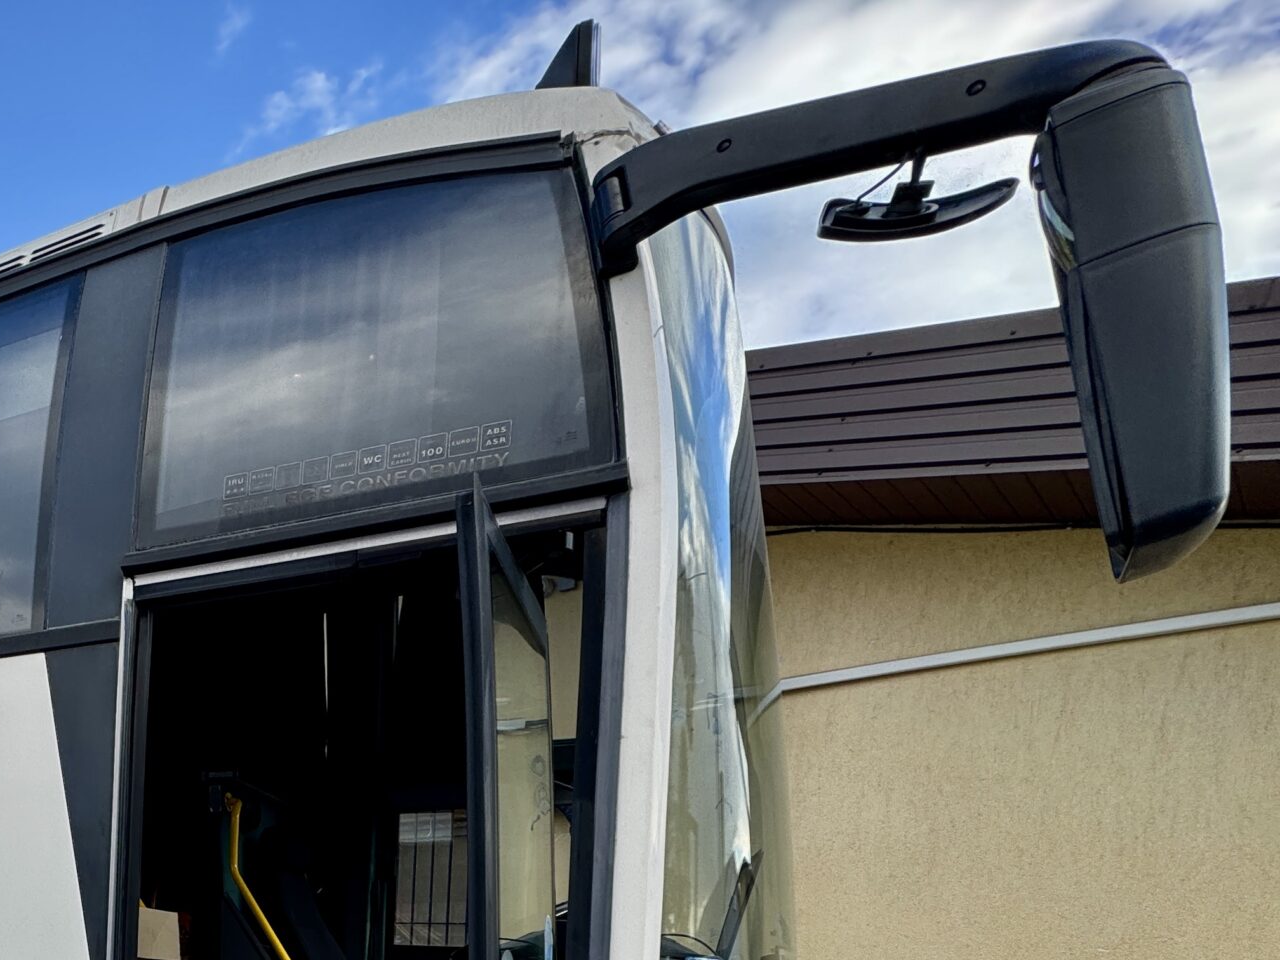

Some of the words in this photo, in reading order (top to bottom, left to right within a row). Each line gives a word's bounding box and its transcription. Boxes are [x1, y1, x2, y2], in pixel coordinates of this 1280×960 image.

[486, 425, 507, 436] ABS
[421, 446, 443, 458] 100
[363, 454, 382, 465] WC
